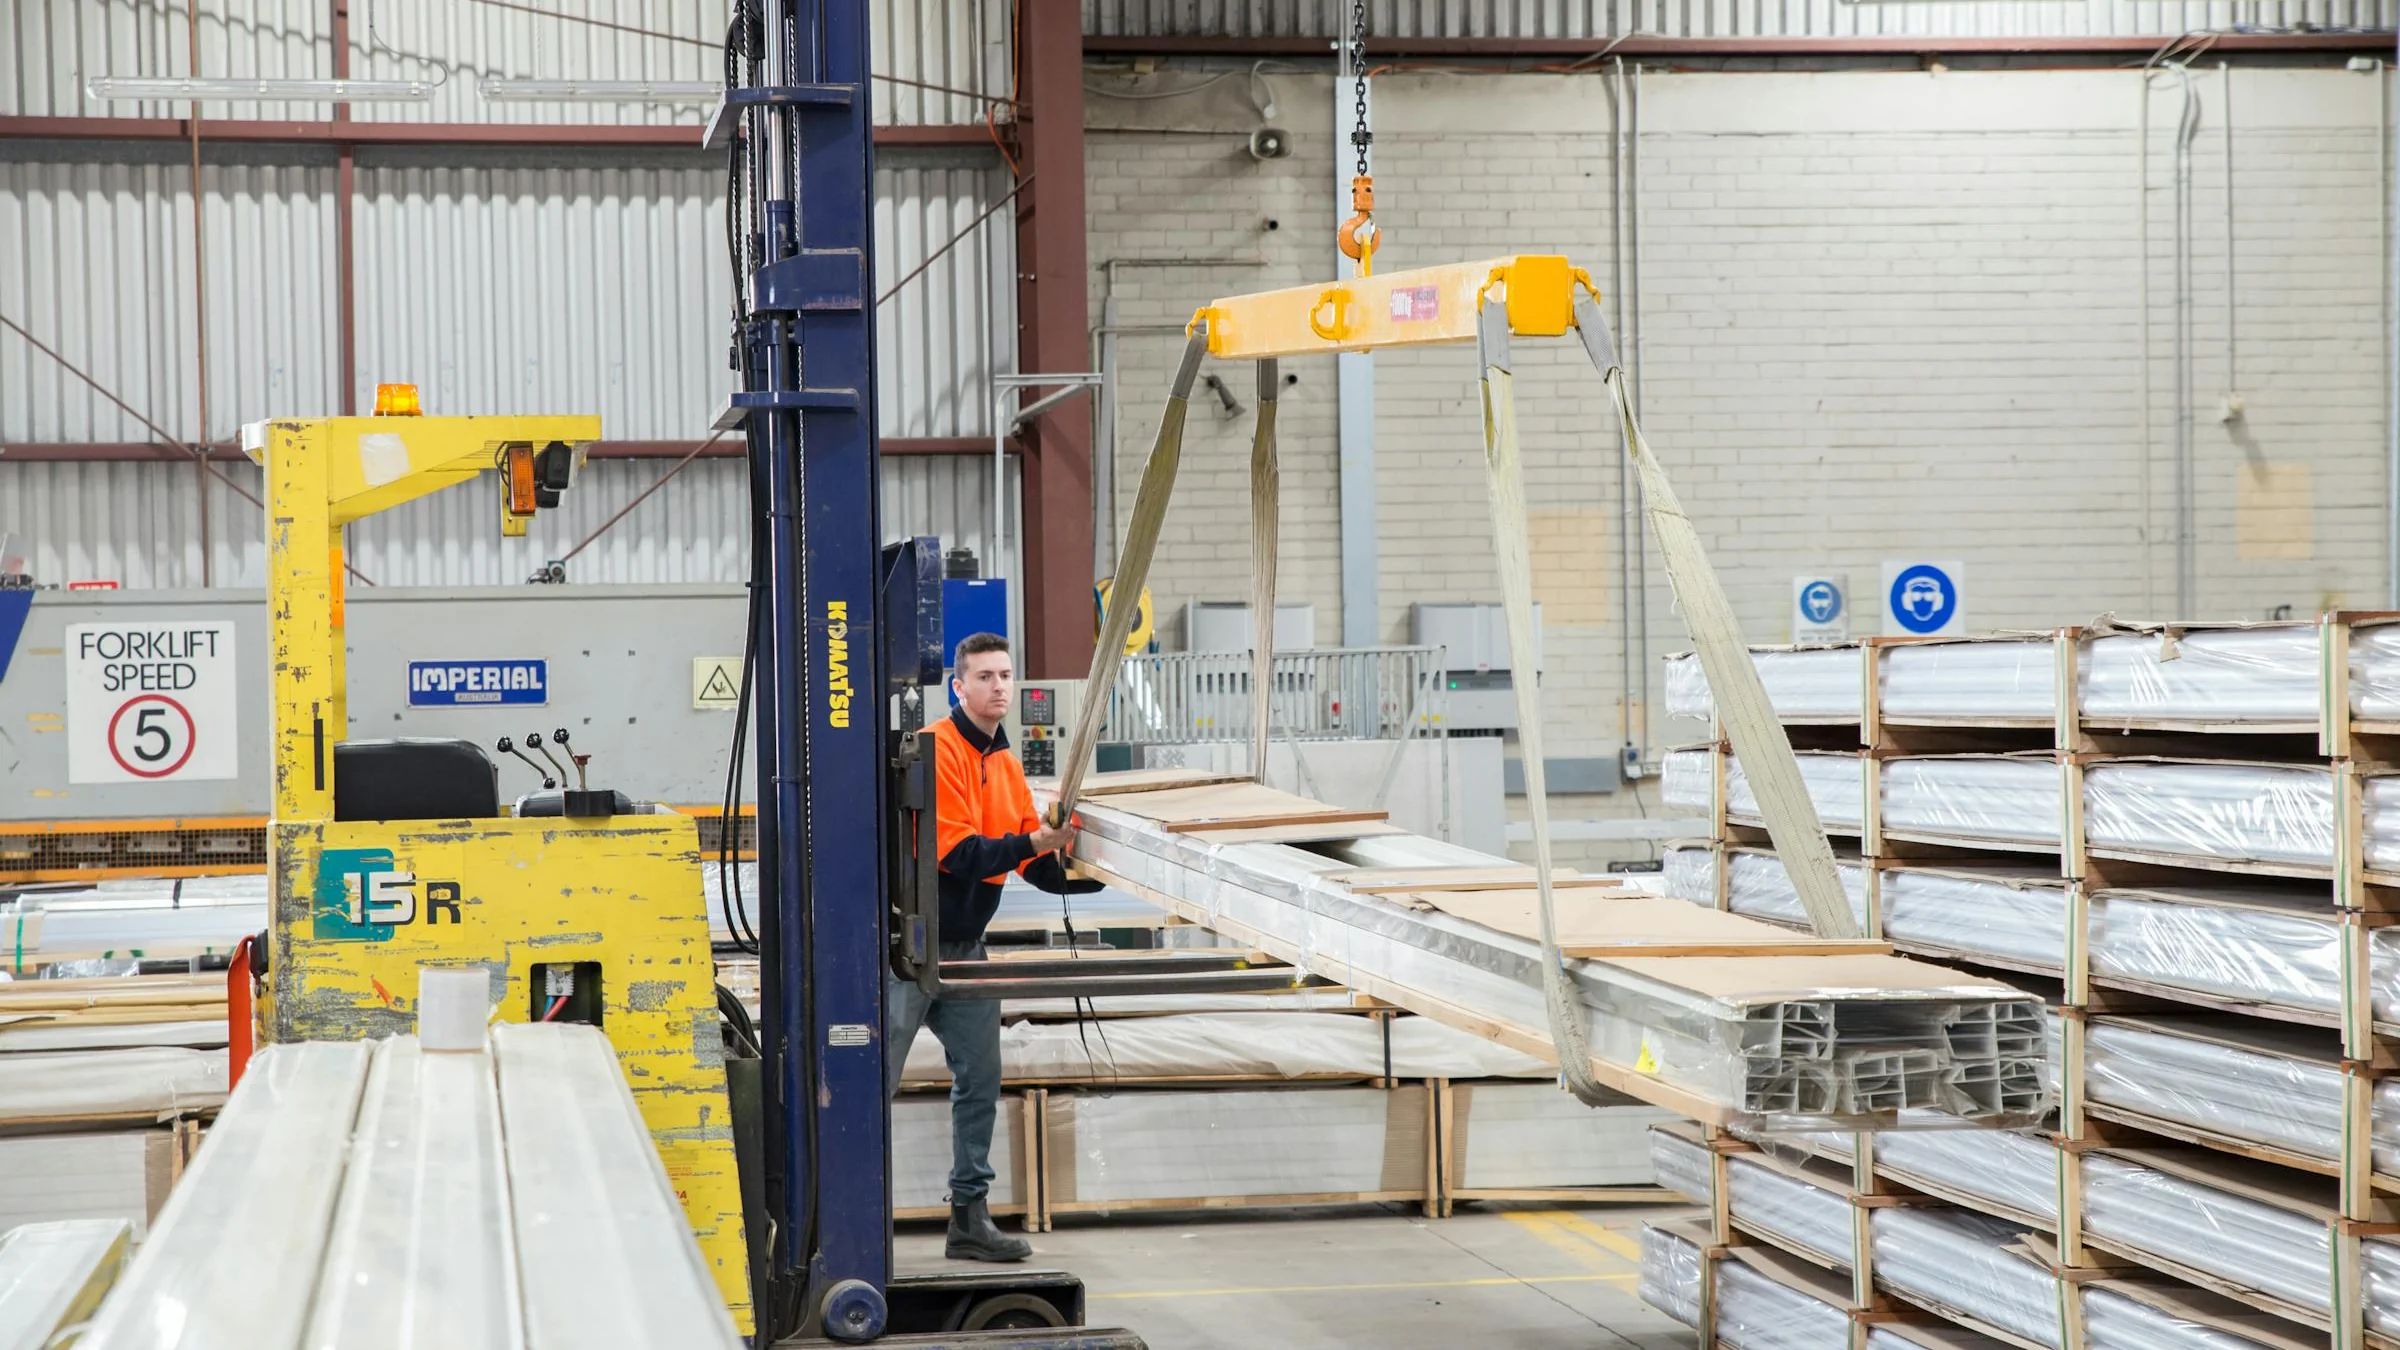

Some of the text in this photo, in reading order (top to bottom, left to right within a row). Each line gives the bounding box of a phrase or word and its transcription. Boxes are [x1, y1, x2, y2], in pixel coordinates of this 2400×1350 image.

[80, 630, 220, 660] FORKLIFT
[103, 662, 197, 692] SPEED
[412, 666, 543, 692] IMPERIAL
[827, 601, 854, 728] KOMATSU
[133, 708, 172, 762] 5
